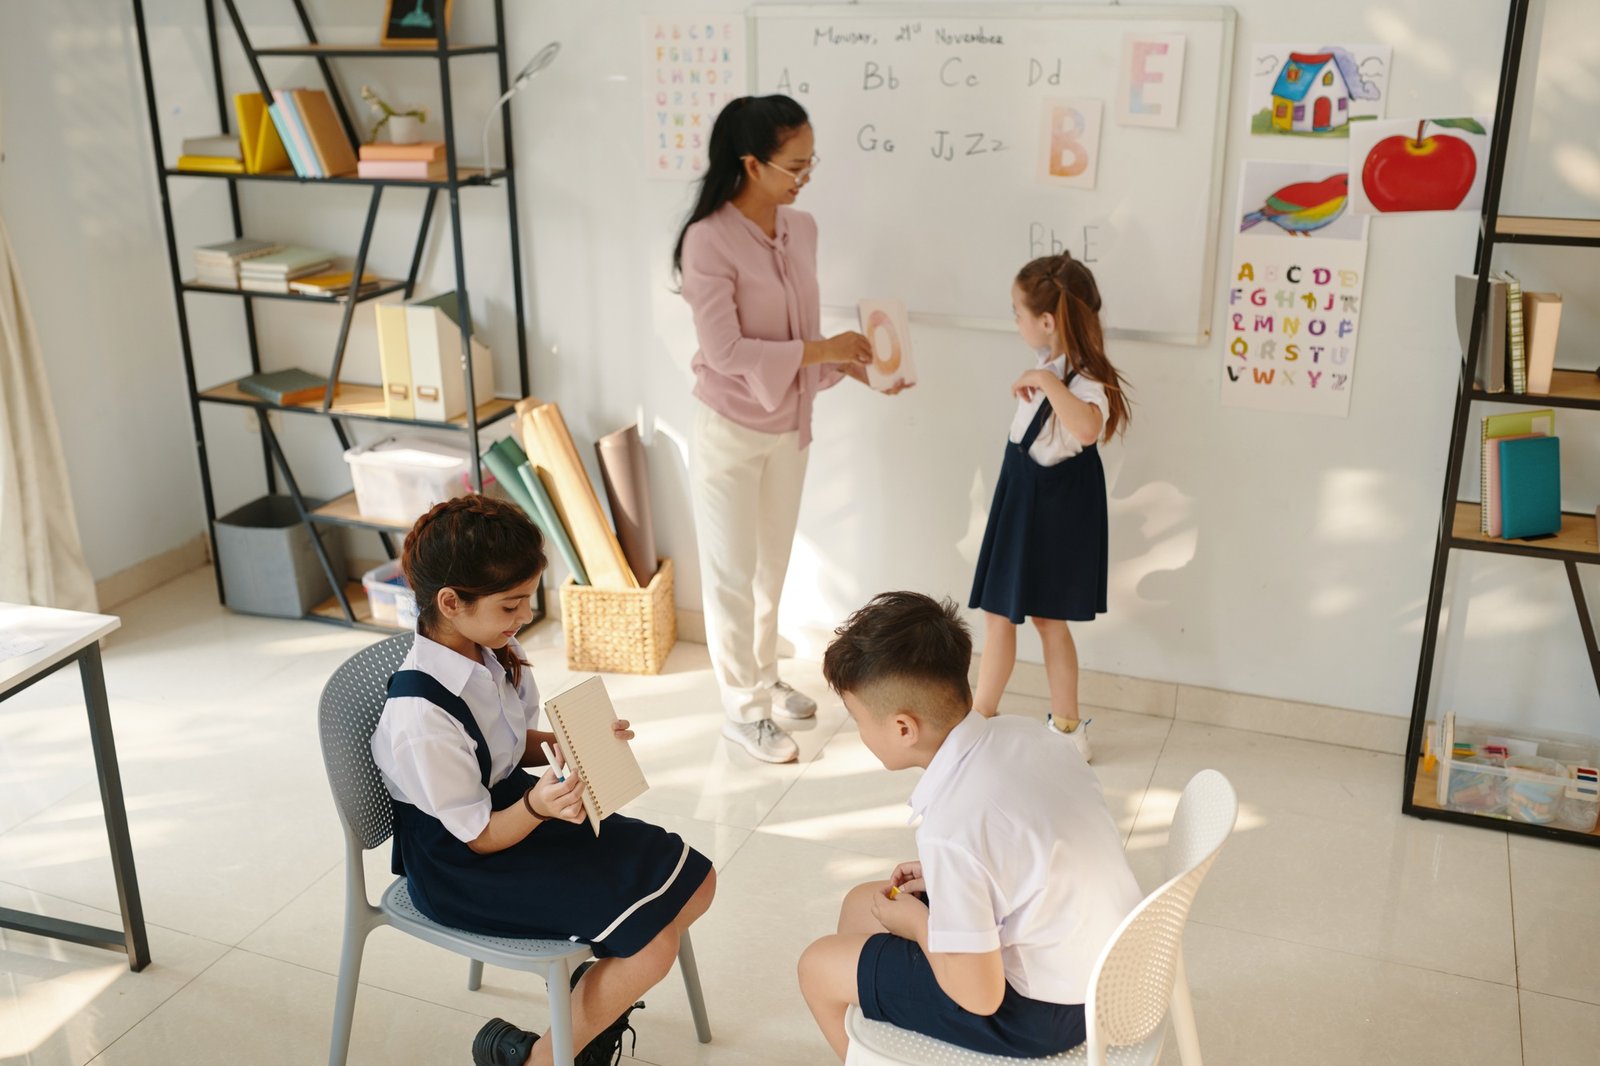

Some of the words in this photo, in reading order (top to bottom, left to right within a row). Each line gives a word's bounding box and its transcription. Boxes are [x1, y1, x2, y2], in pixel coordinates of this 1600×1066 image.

[863, 61, 900, 90] Bb
[940, 56, 980, 87] Cc
[1027, 58, 1062, 87] Dd
[1129, 41, 1169, 114] E
[659, 132, 667, 149] 1
[675, 132, 685, 149] 2
[693, 133, 701, 149] 3
[930, 130, 954, 162] Jj
[1049, 105, 1088, 177] B
[659, 155, 668, 170] 6
[677, 155, 684, 170] 7
[1237, 262, 1254, 282] A
[1286, 265, 1302, 283] C
[1312, 267, 1331, 285] D
[1230, 288, 1243, 305] F
[1250, 288, 1267, 306] G
[1275, 289, 1295, 308] H
[1323, 293, 1335, 311] J
[1254, 315, 1274, 333] M
[1283, 317, 1300, 336] N
[1308, 319, 1326, 336] O
[1230, 337, 1248, 361] Q
[1260, 339, 1277, 360] R
[1284, 344, 1300, 361] S
[1309, 346, 1325, 363] T
[1253, 367, 1276, 385] W
[1307, 370, 1322, 388] Y
